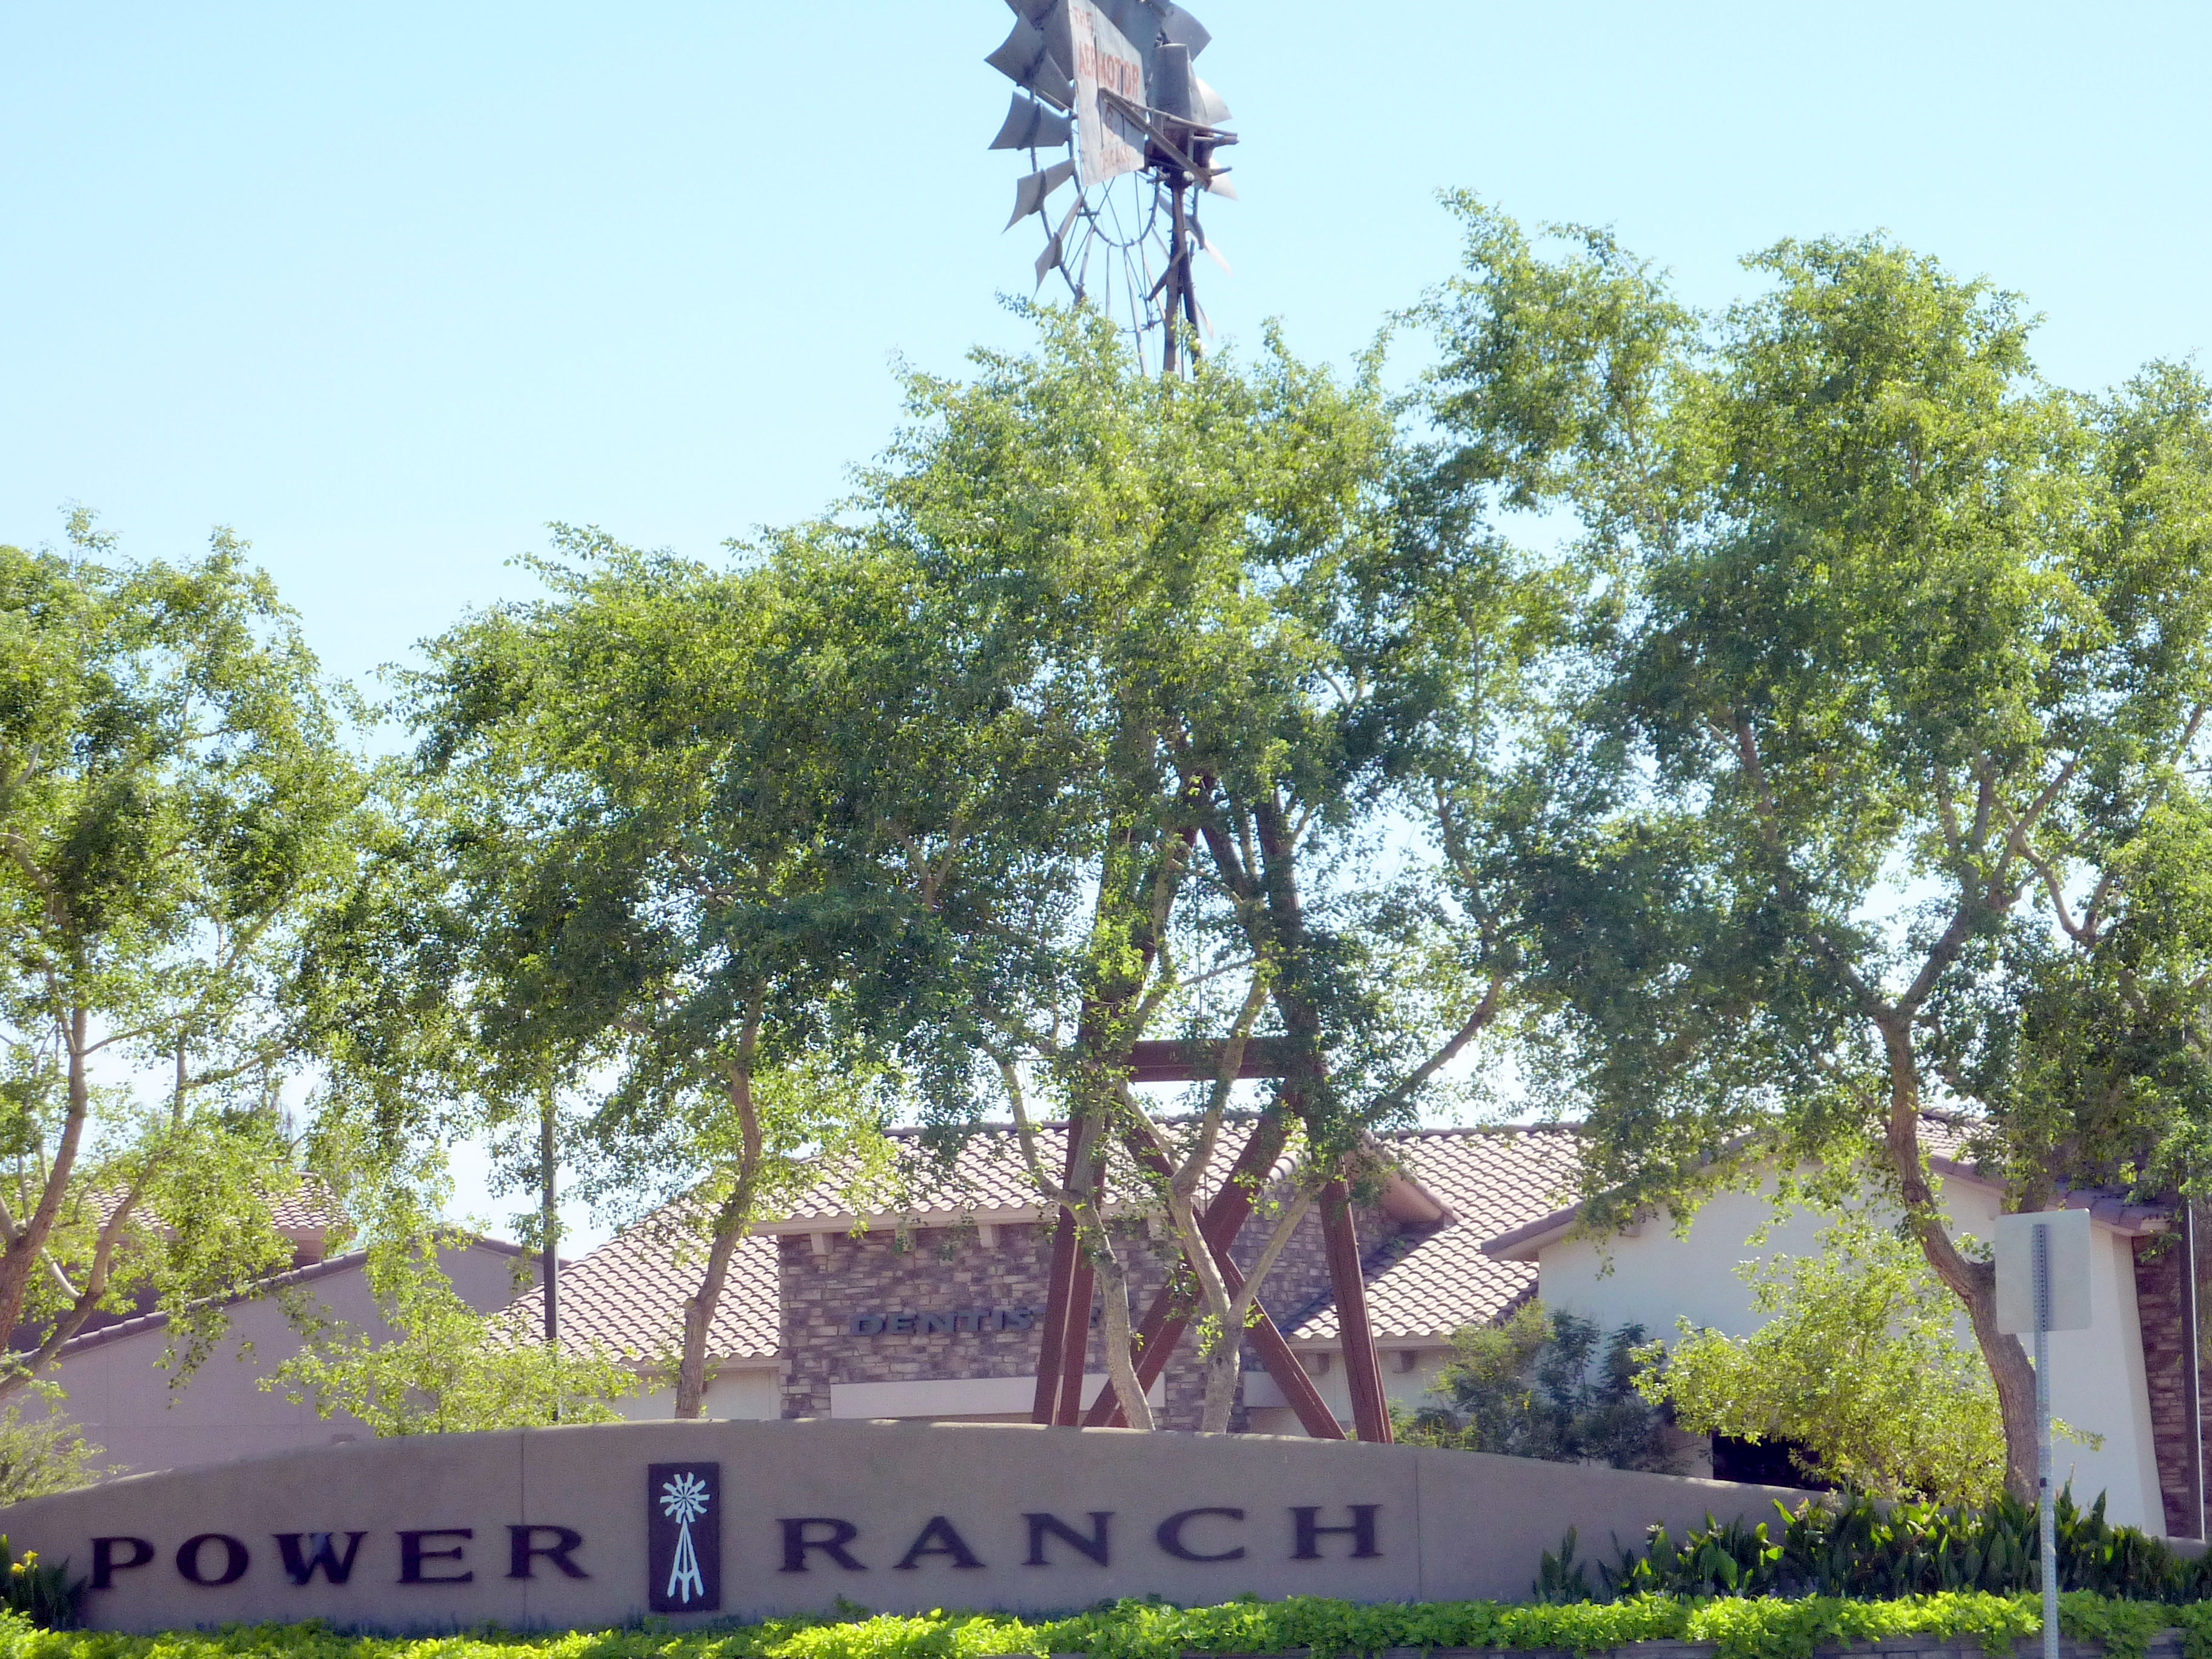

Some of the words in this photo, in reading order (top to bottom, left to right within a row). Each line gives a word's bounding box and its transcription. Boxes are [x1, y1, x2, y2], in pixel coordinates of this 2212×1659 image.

[1072, 6, 1093, 30] THE
[1078, 41, 1139, 101] AERMOTOR
[1099, 144, 1132, 173] CHICAGO
[88, 1524, 593, 1590] POWER
[777, 1504, 1384, 1573] RANCH
